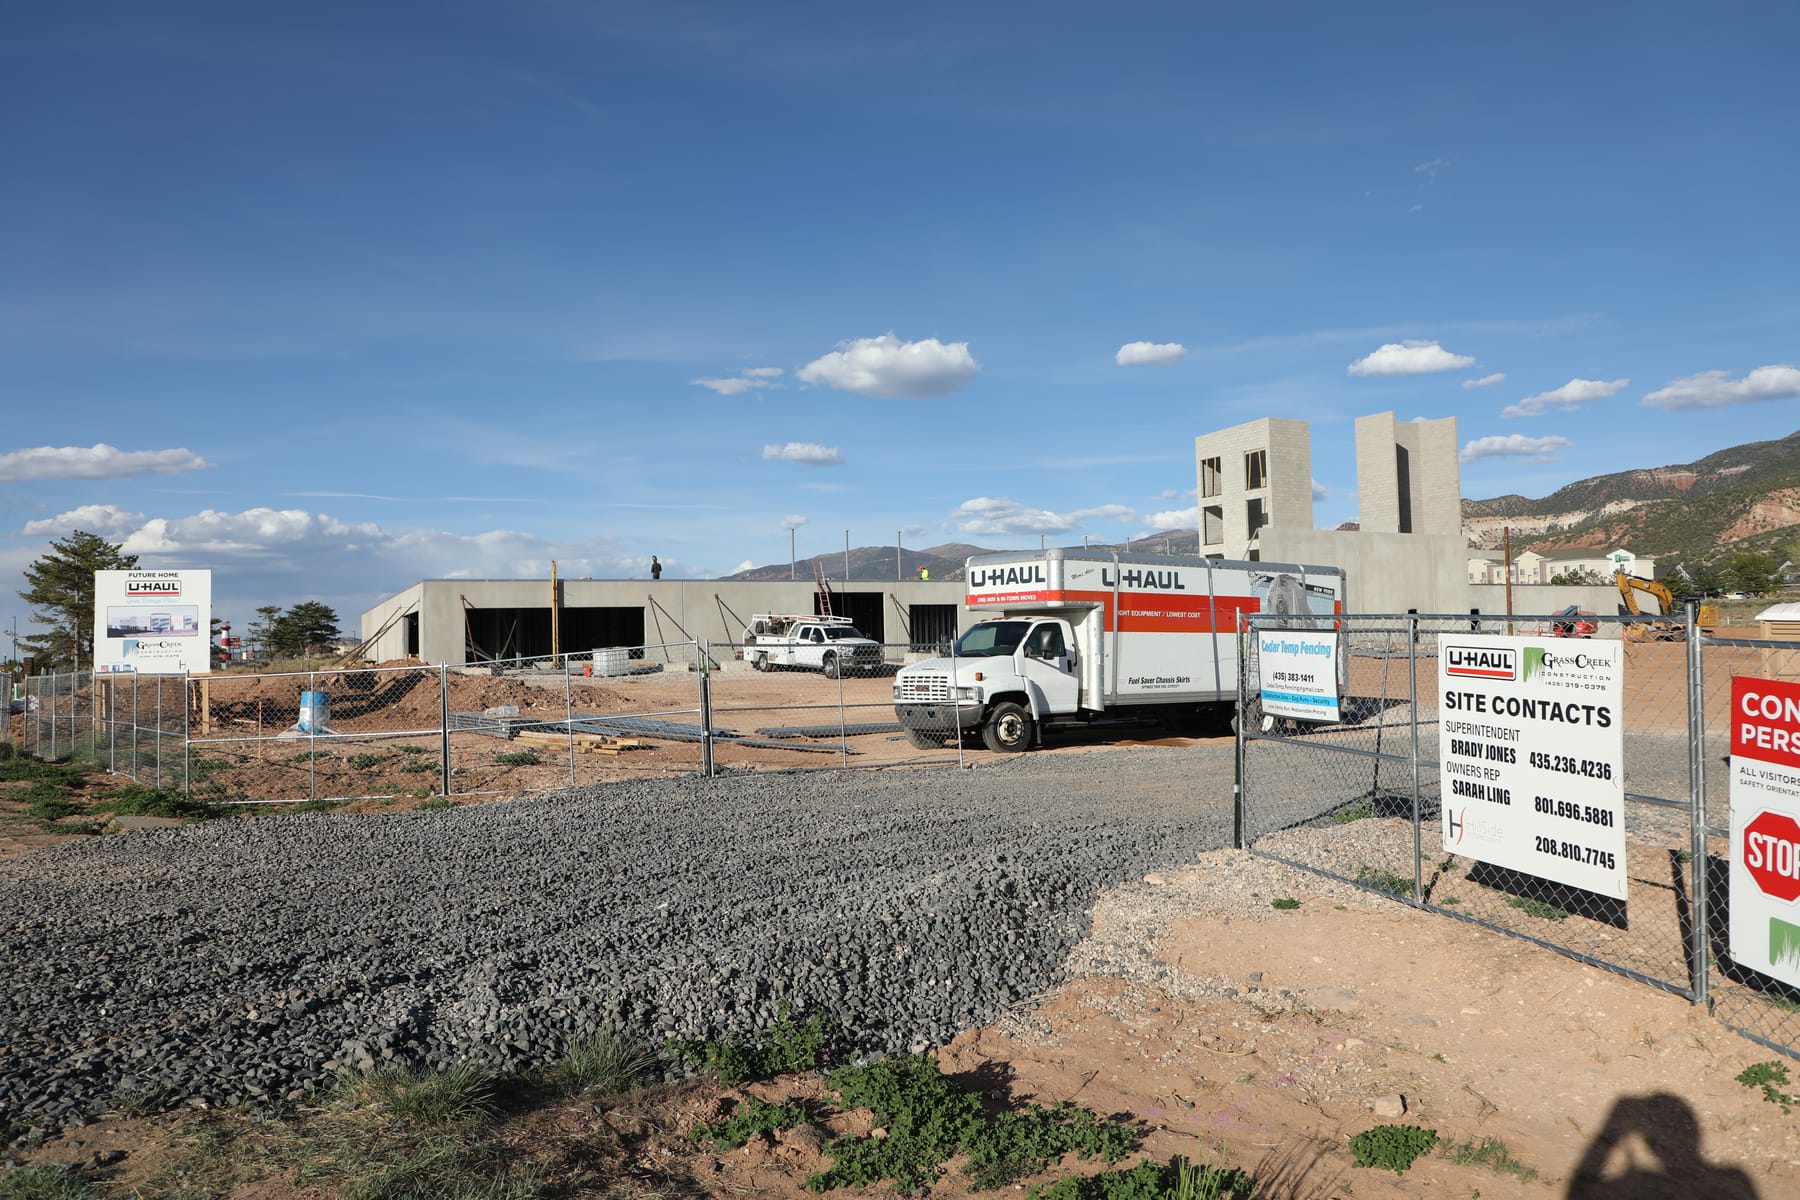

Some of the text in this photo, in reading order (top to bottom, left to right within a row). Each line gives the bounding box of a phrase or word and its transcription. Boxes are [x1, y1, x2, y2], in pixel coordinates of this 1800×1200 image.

[129, 583, 179, 591] U-HAUL
[971, 565, 1046, 587] U-HAUL
[1102, 568, 1185, 590] U-HAUL
[1262, 640, 1331, 658] Cedar Temp Fencing
[1449, 651, 1513, 669] U-HAUL
[1273, 672, 1314, 682] (435) 383-1411
[1541, 671, 1612, 681] CONSTRUCTION
[1445, 690, 1612, 728] SITE CONTACTS
[1445, 720, 1521, 742] SUPERINTENDENT
[1741, 722, 1800, 755] PERS
[1451, 738, 1612, 781] BRADY JONES 435.236.4236
[1446, 761, 1501, 782] OWNERS REP
[1740, 766, 1757, 778] ALL
[1452, 779, 1511, 806] SARAH LING
[1740, 779, 1765, 789] SAFETY
[1534, 795, 1614, 828] 801.696.5881
[1535, 835, 1616, 871] 208.810.7745
